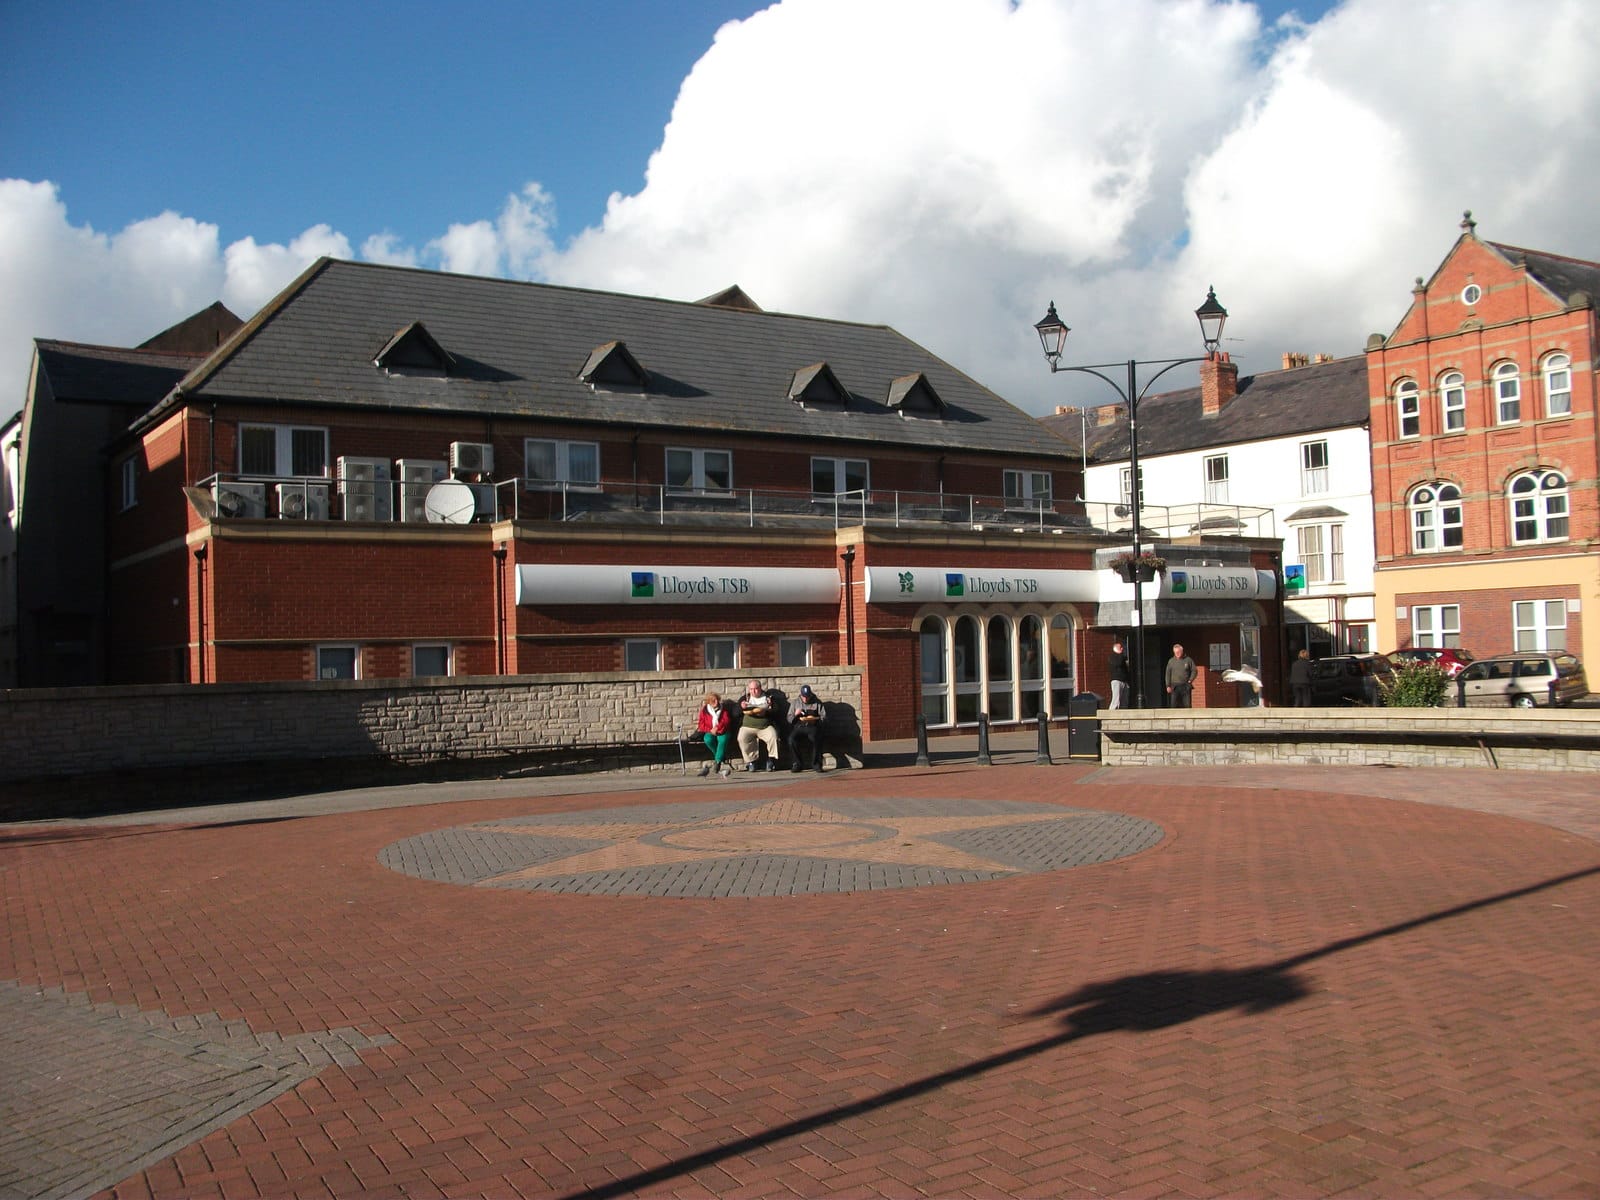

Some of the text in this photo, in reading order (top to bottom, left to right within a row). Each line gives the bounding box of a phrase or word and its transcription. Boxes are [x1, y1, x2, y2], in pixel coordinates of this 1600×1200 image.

[662, 576, 749, 599] Lloyds TSB
[970, 577, 1038, 598] Lloyds TSB
[1191, 575, 1248, 595] Lloyds TSB
